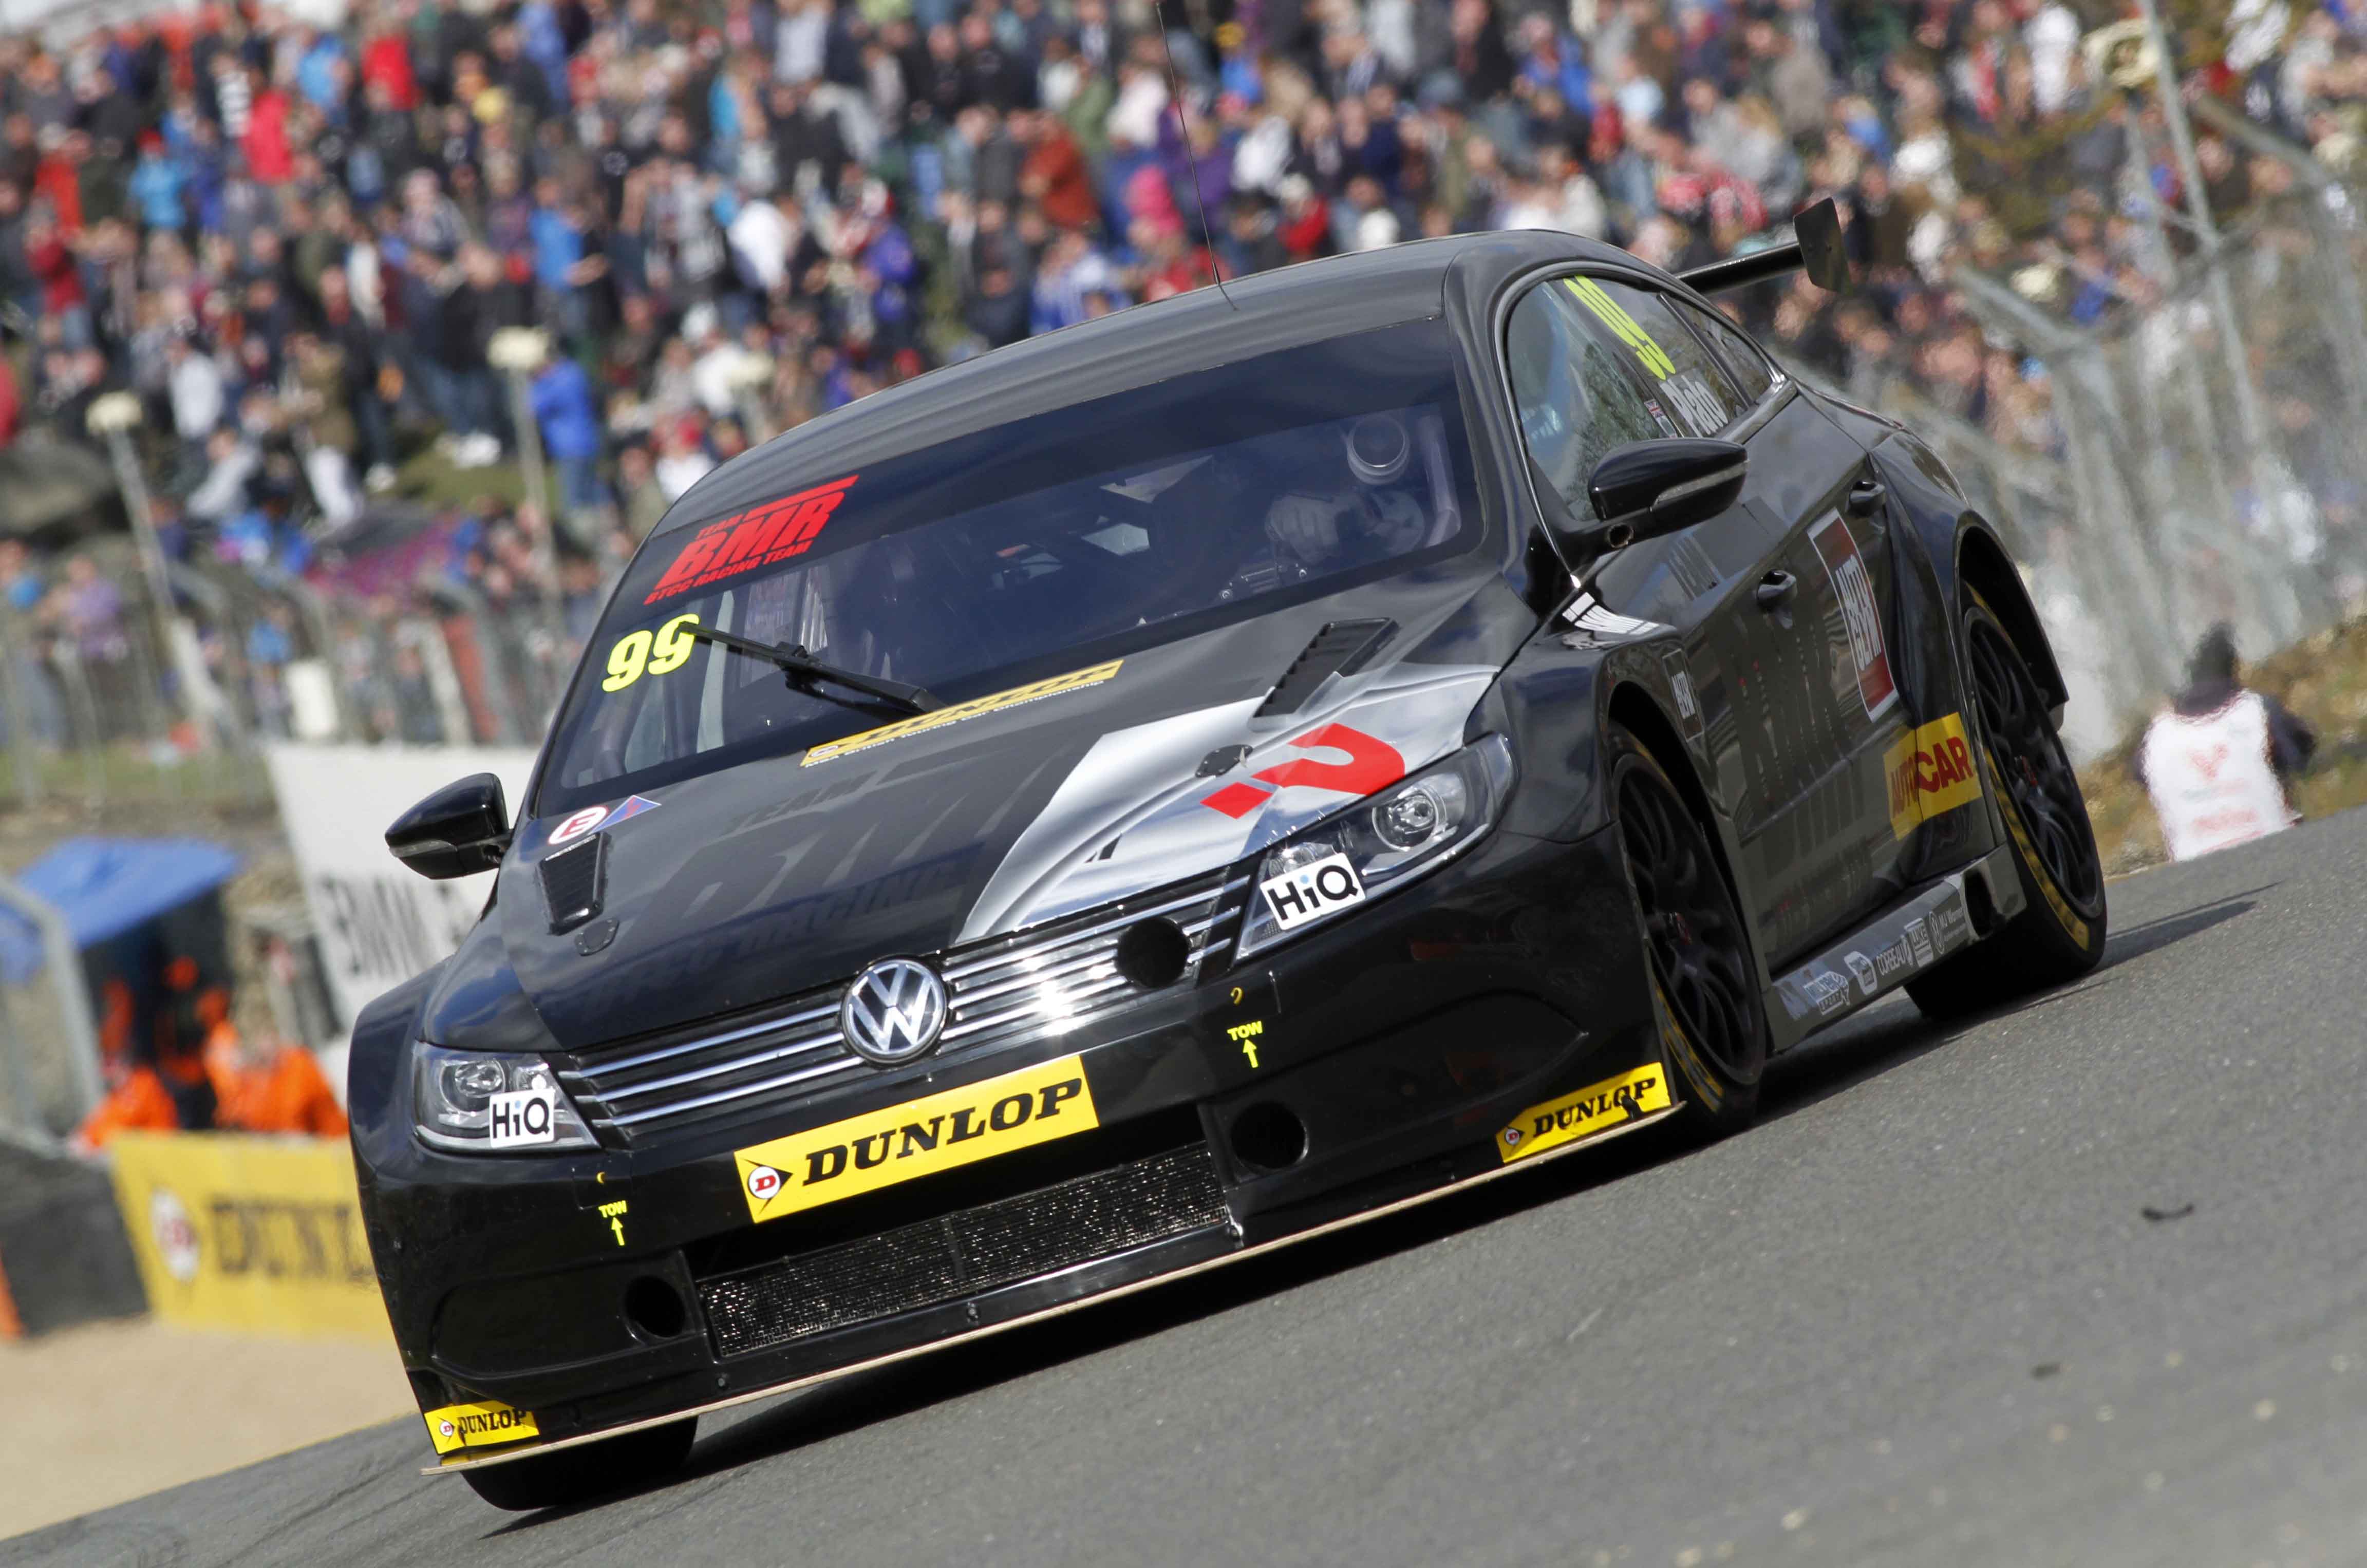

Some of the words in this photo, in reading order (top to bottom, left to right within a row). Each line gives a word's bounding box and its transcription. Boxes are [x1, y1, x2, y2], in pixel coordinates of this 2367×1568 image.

[653, 490, 846, 592] BMR
[692, 555, 763, 588] RACING
[763, 540, 815, 565] TEAM
[602, 613, 700, 692] 99
[1267, 864, 1359, 921] HiQ
[1227, 1021, 1263, 1041] TOW
[492, 1096, 551, 1139] HiQ
[803, 1078, 1082, 1186] DUNLOP
[1533, 1077, 1656, 1138] DUNLOP
[598, 1199, 628, 1218] TOW
[211, 1197, 376, 1280] DUNL
[457, 1408, 527, 1435] DUNLOP
